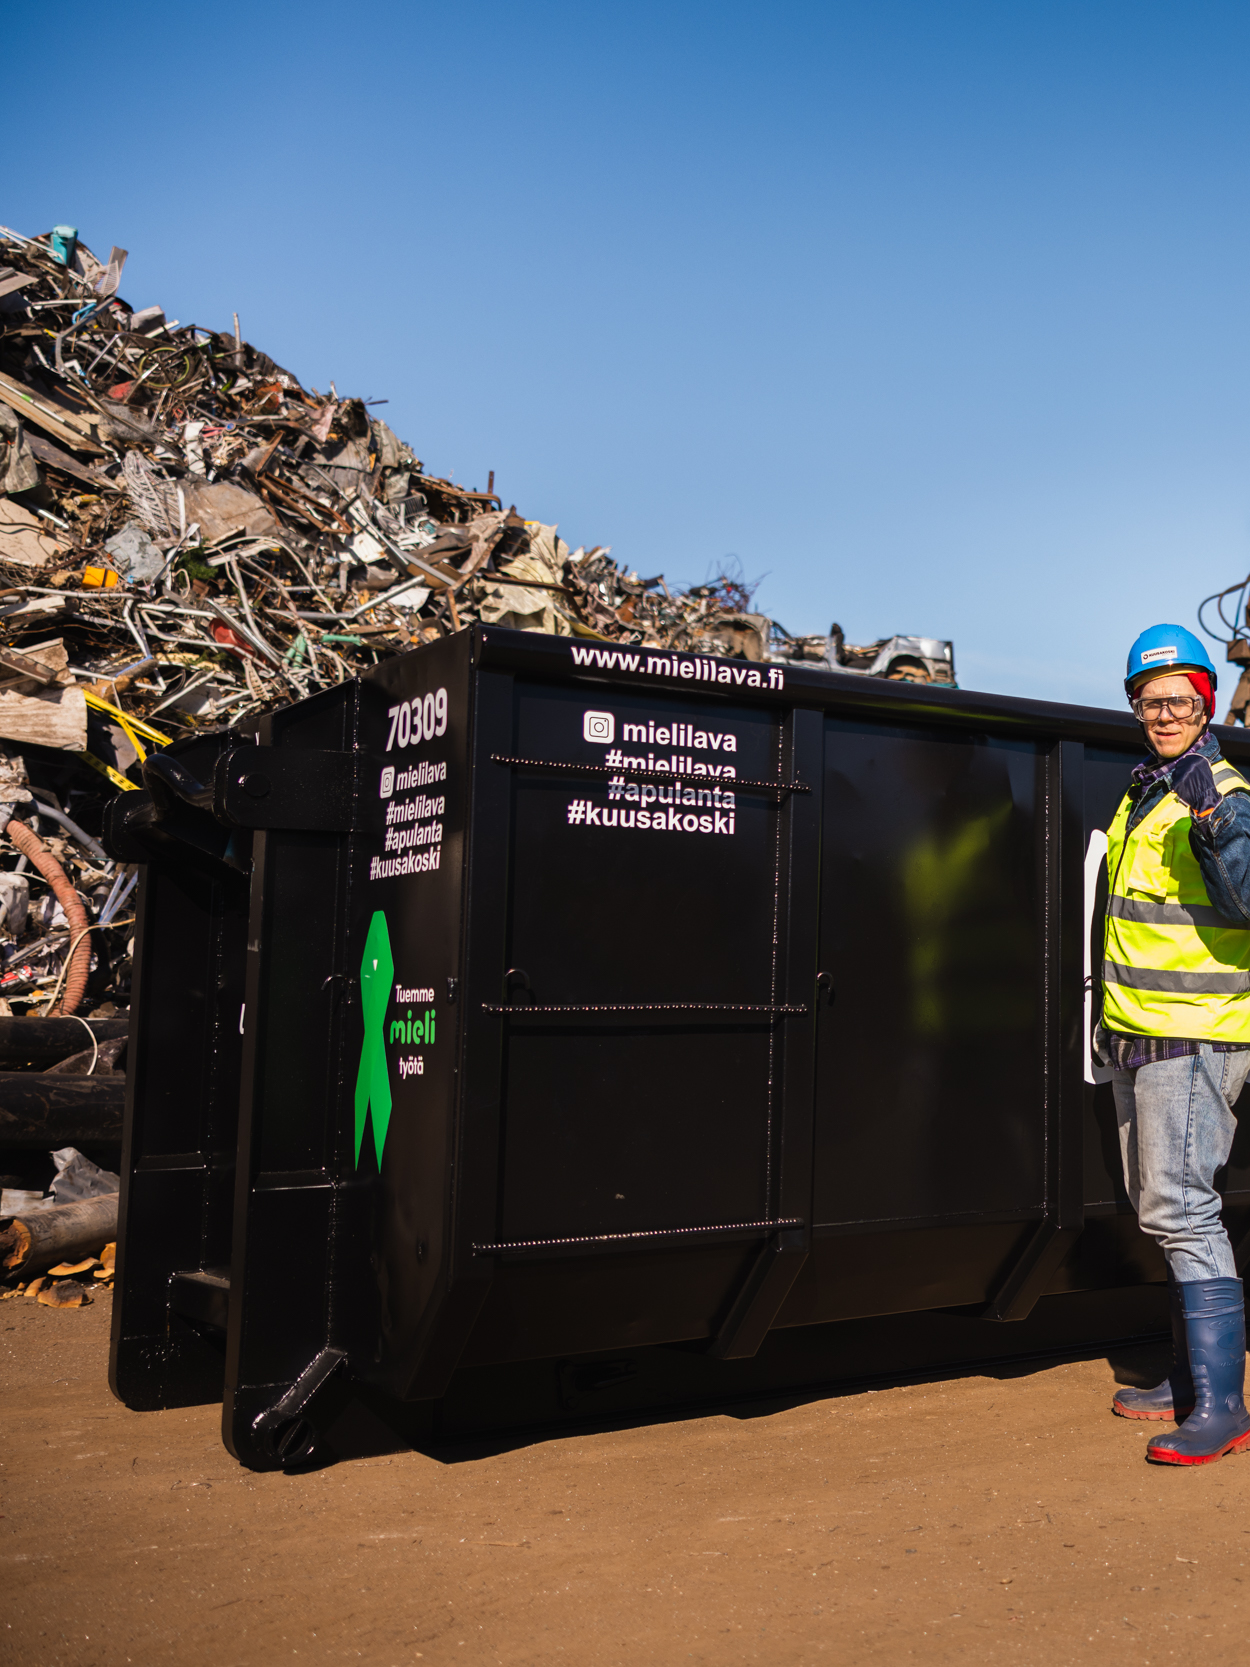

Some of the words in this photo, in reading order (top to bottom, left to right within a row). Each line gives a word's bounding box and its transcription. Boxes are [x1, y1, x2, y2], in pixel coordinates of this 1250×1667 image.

[571, 646, 784, 691] www.mielilava.fi
[385, 687, 448, 752] 70309
[623, 720, 737, 752] mielilava
[396, 760, 447, 791] mielilava
[608, 775, 736, 809] #apulanta
[386, 794, 446, 826] #mielilava
[567, 799, 735, 835] #kuusakoski
[384, 820, 443, 855] #apulanta
[370, 845, 441, 880] #kuusakoski
[395, 984, 435, 1003] Tuemme
[389, 1009, 436, 1045] mieli
[398, 1055, 424, 1080] työtä
